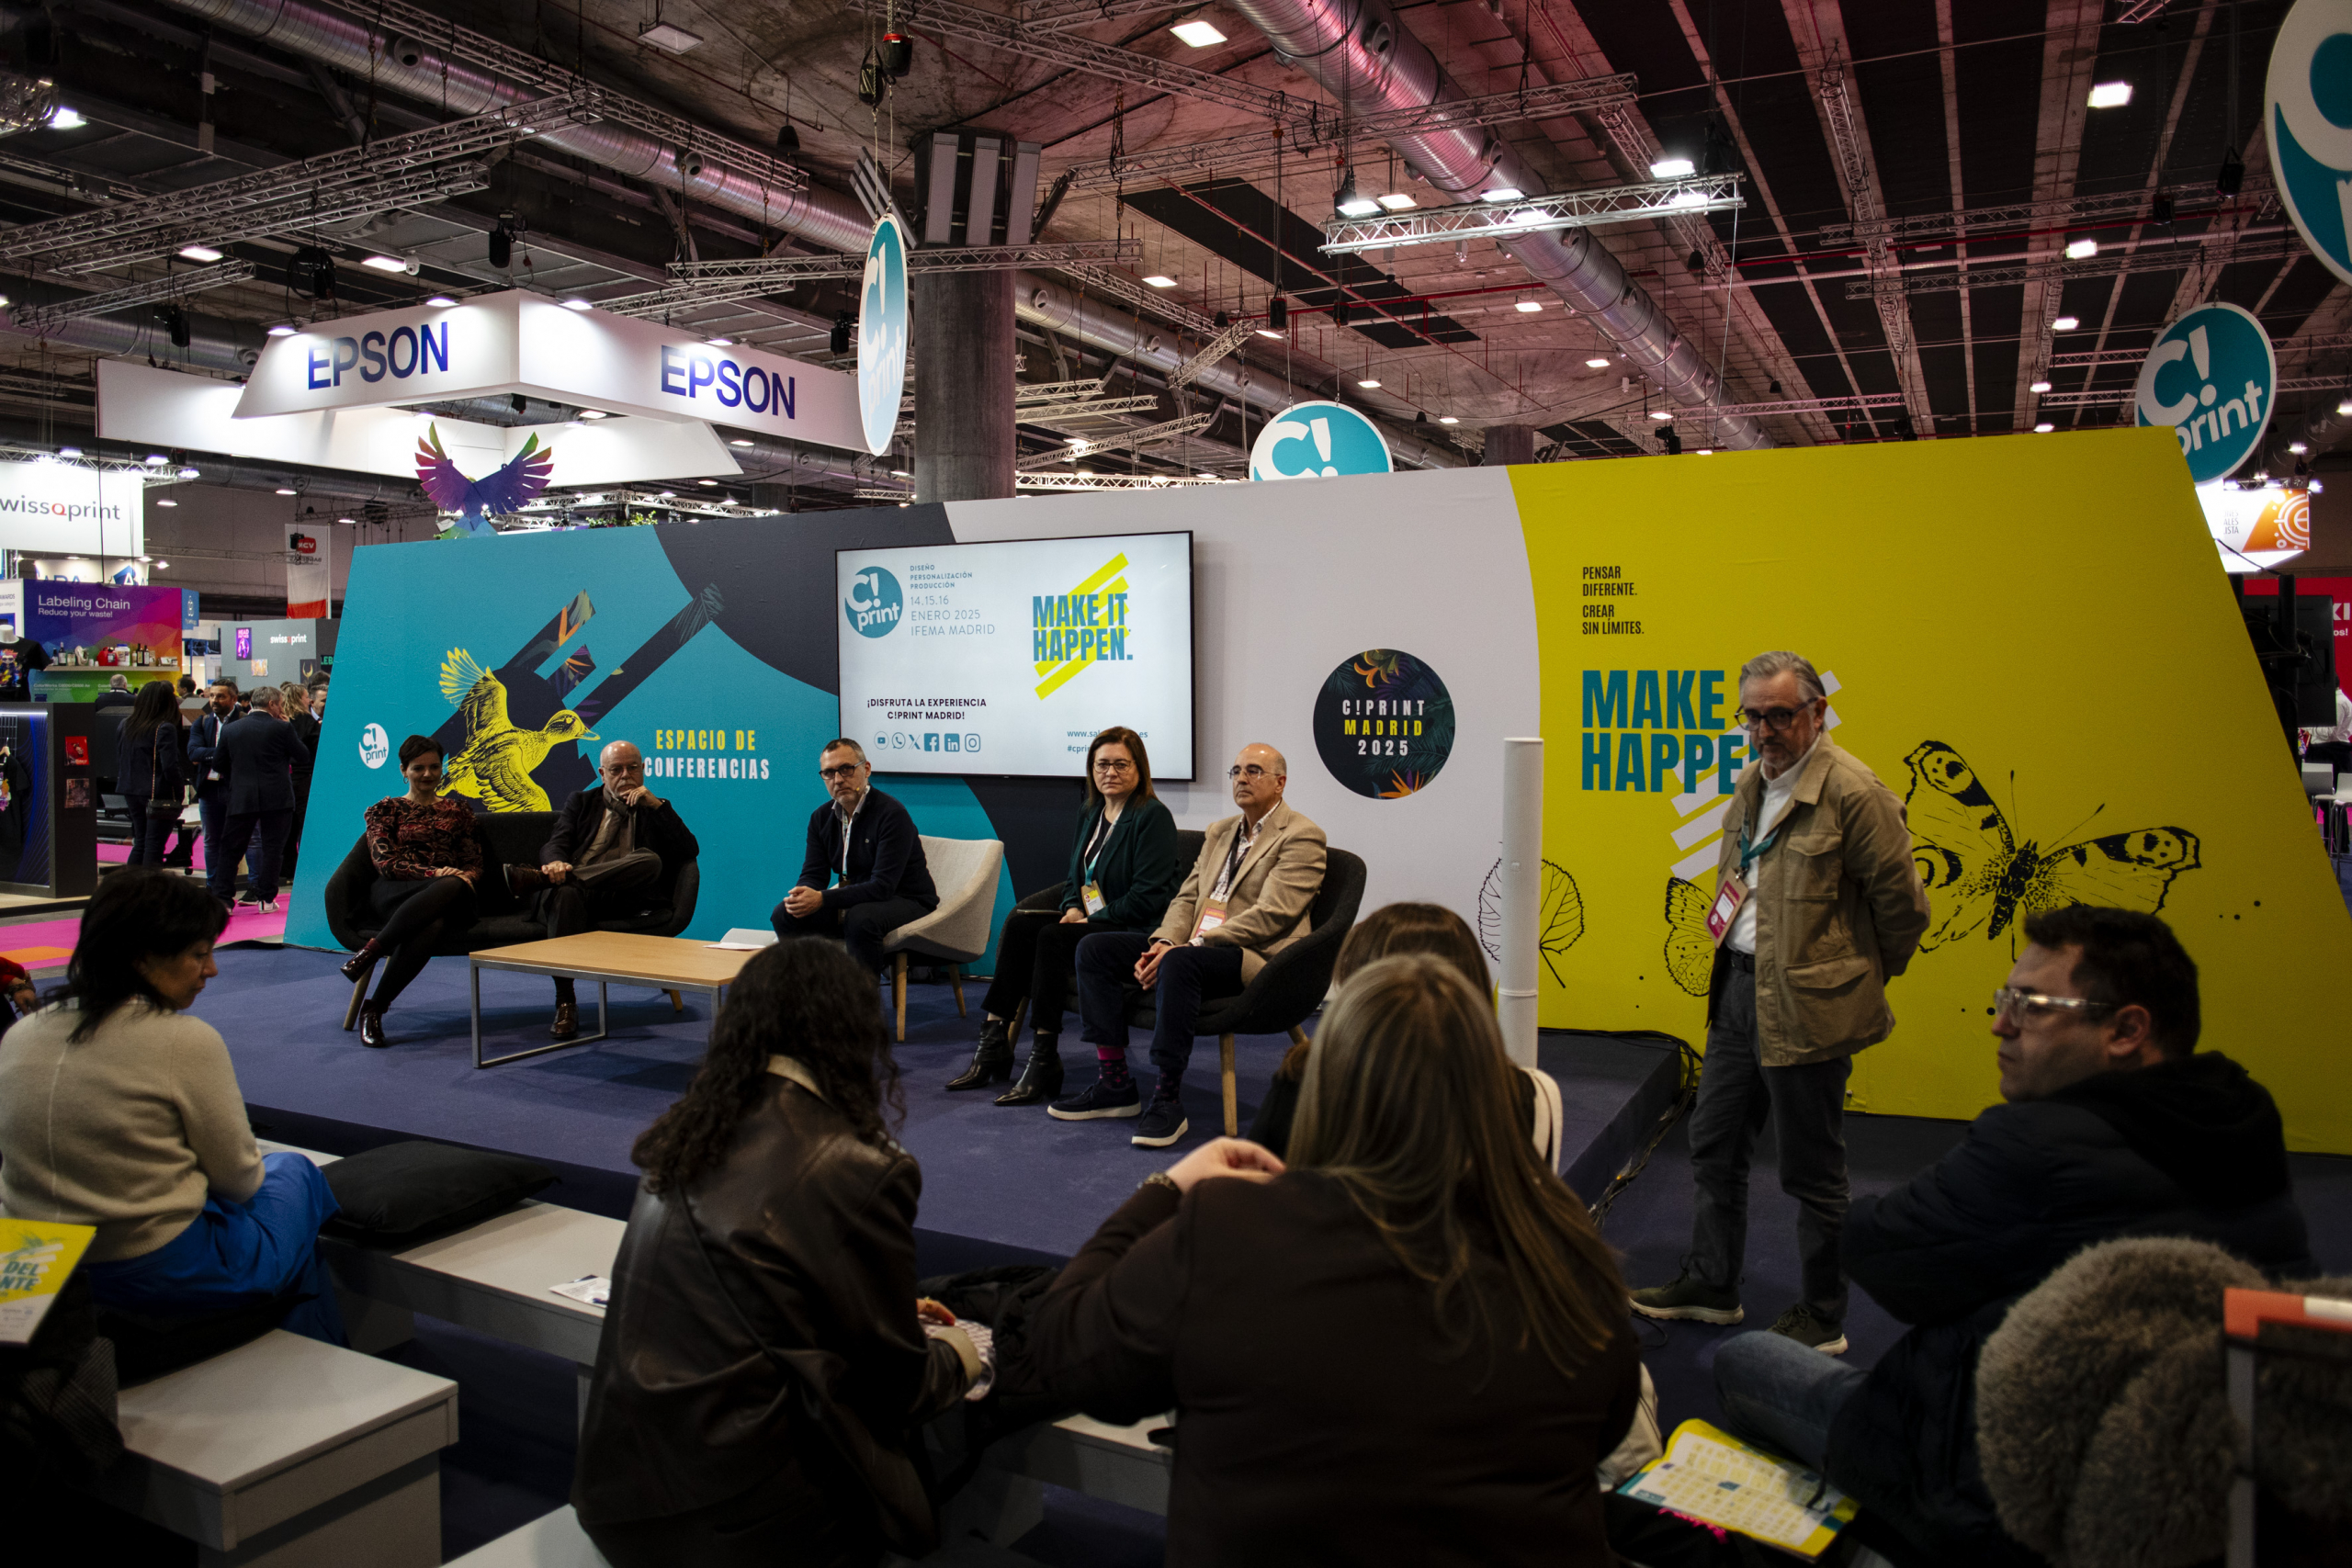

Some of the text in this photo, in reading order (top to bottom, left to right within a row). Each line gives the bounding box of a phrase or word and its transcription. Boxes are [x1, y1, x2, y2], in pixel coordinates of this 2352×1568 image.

[308, 321, 449, 391] EPSON
[661, 344, 797, 420] EPSON
[867, 325, 903, 429] print
[910, 564, 935, 572] DISEÑO
[910, 571, 973, 581] PERSONALIZACIÓN
[1582, 566, 1622, 580] PENSAR
[910, 580, 956, 590] PRODUCCIÓN
[1582, 582, 1638, 597] DIFERENTE.
[38, 594, 130, 611] Labeling Chain
[910, 595, 950, 606] 14.15.16
[38, 607, 69, 616] Reduce
[70, 610, 87, 618] your
[856, 605, 901, 632] print
[910, 609, 981, 622] ENERO 2025
[1032, 593, 1128, 628] MAKE IT
[1582, 604, 1615, 618] CREAR
[910, 624, 996, 637] IFEMA MADRID
[1582, 618, 1645, 635] SIN LÍMITES.
[2333, 627, 2348, 637] os!
[1033, 628, 1134, 661] HAPPEN.
[866, 698, 987, 708] ¡DISFRUTA LA EXPERIENCIA
[1342, 699, 1425, 716] C!PRINT
[1582, 670, 1726, 730] MAKE
[888, 711, 966, 720] C!PRINT MADRID!
[1344, 719, 1423, 736] MADRID
[656, 729, 757, 751] ESPACIO DE
[1358, 740, 1408, 756] 2025
[365, 745, 387, 763] print
[1067, 745, 1090, 754] #cpri
[644, 756, 771, 780] CONFERENCIAS
[1581, 733, 1762, 795] HAPPE
[4, 1260, 40, 1277] DEL
[0, 1277, 40, 1292] NTE
